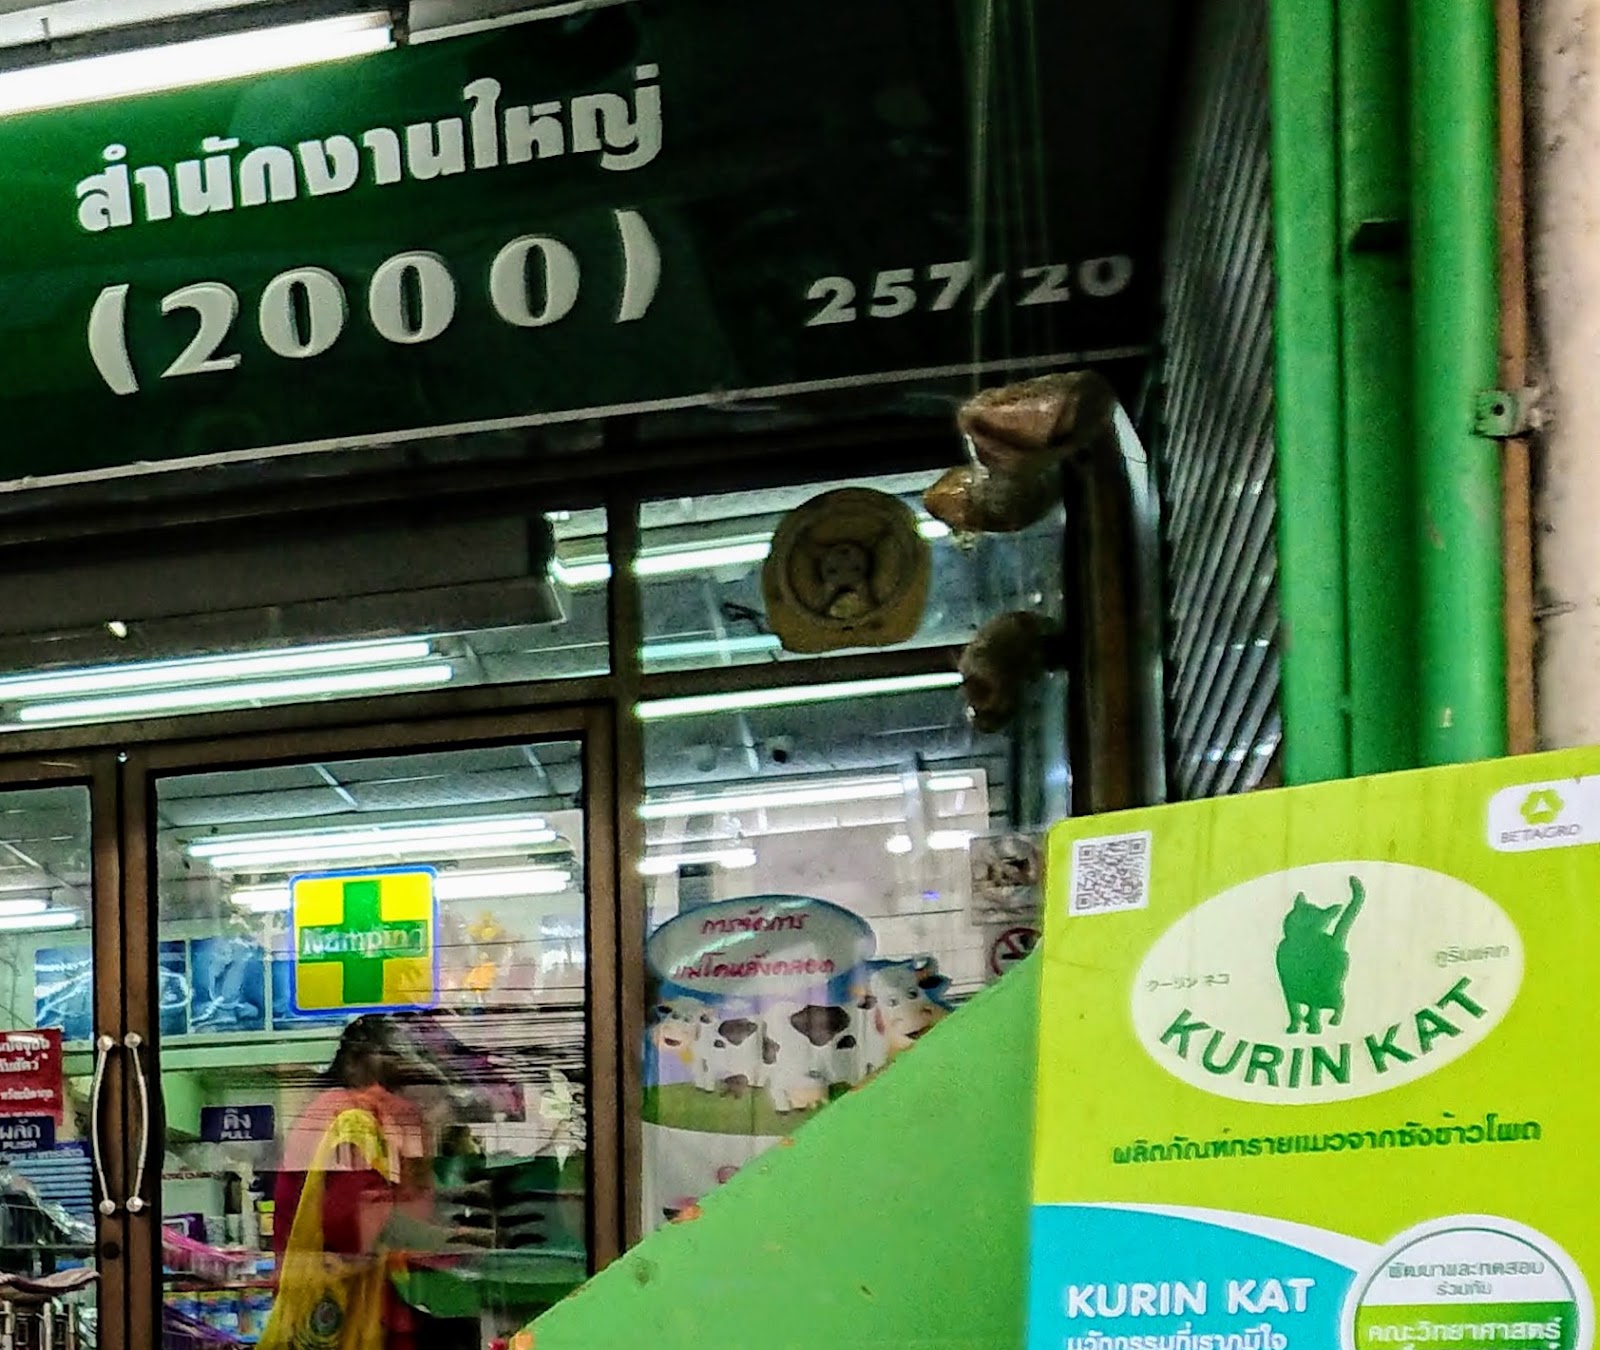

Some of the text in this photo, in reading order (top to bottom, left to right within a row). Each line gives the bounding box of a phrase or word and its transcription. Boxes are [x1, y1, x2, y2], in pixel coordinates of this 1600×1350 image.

[75, 64, 663, 232] สำนักงานใหญ่
[87, 208, 663, 394] (2000)
[804, 253, 1132, 328] 257/20
[1501, 823, 1582, 843] BETAGRO
[300, 925, 424, 959] Namping
[1159, 976, 1489, 1088] KURIN KAT
[220, 1130, 253, 1140] PULL
[1068, 1277, 1316, 1318] KURIN KAT
[1368, 1316, 1563, 1342] คณะวิทยาศาสตร์
